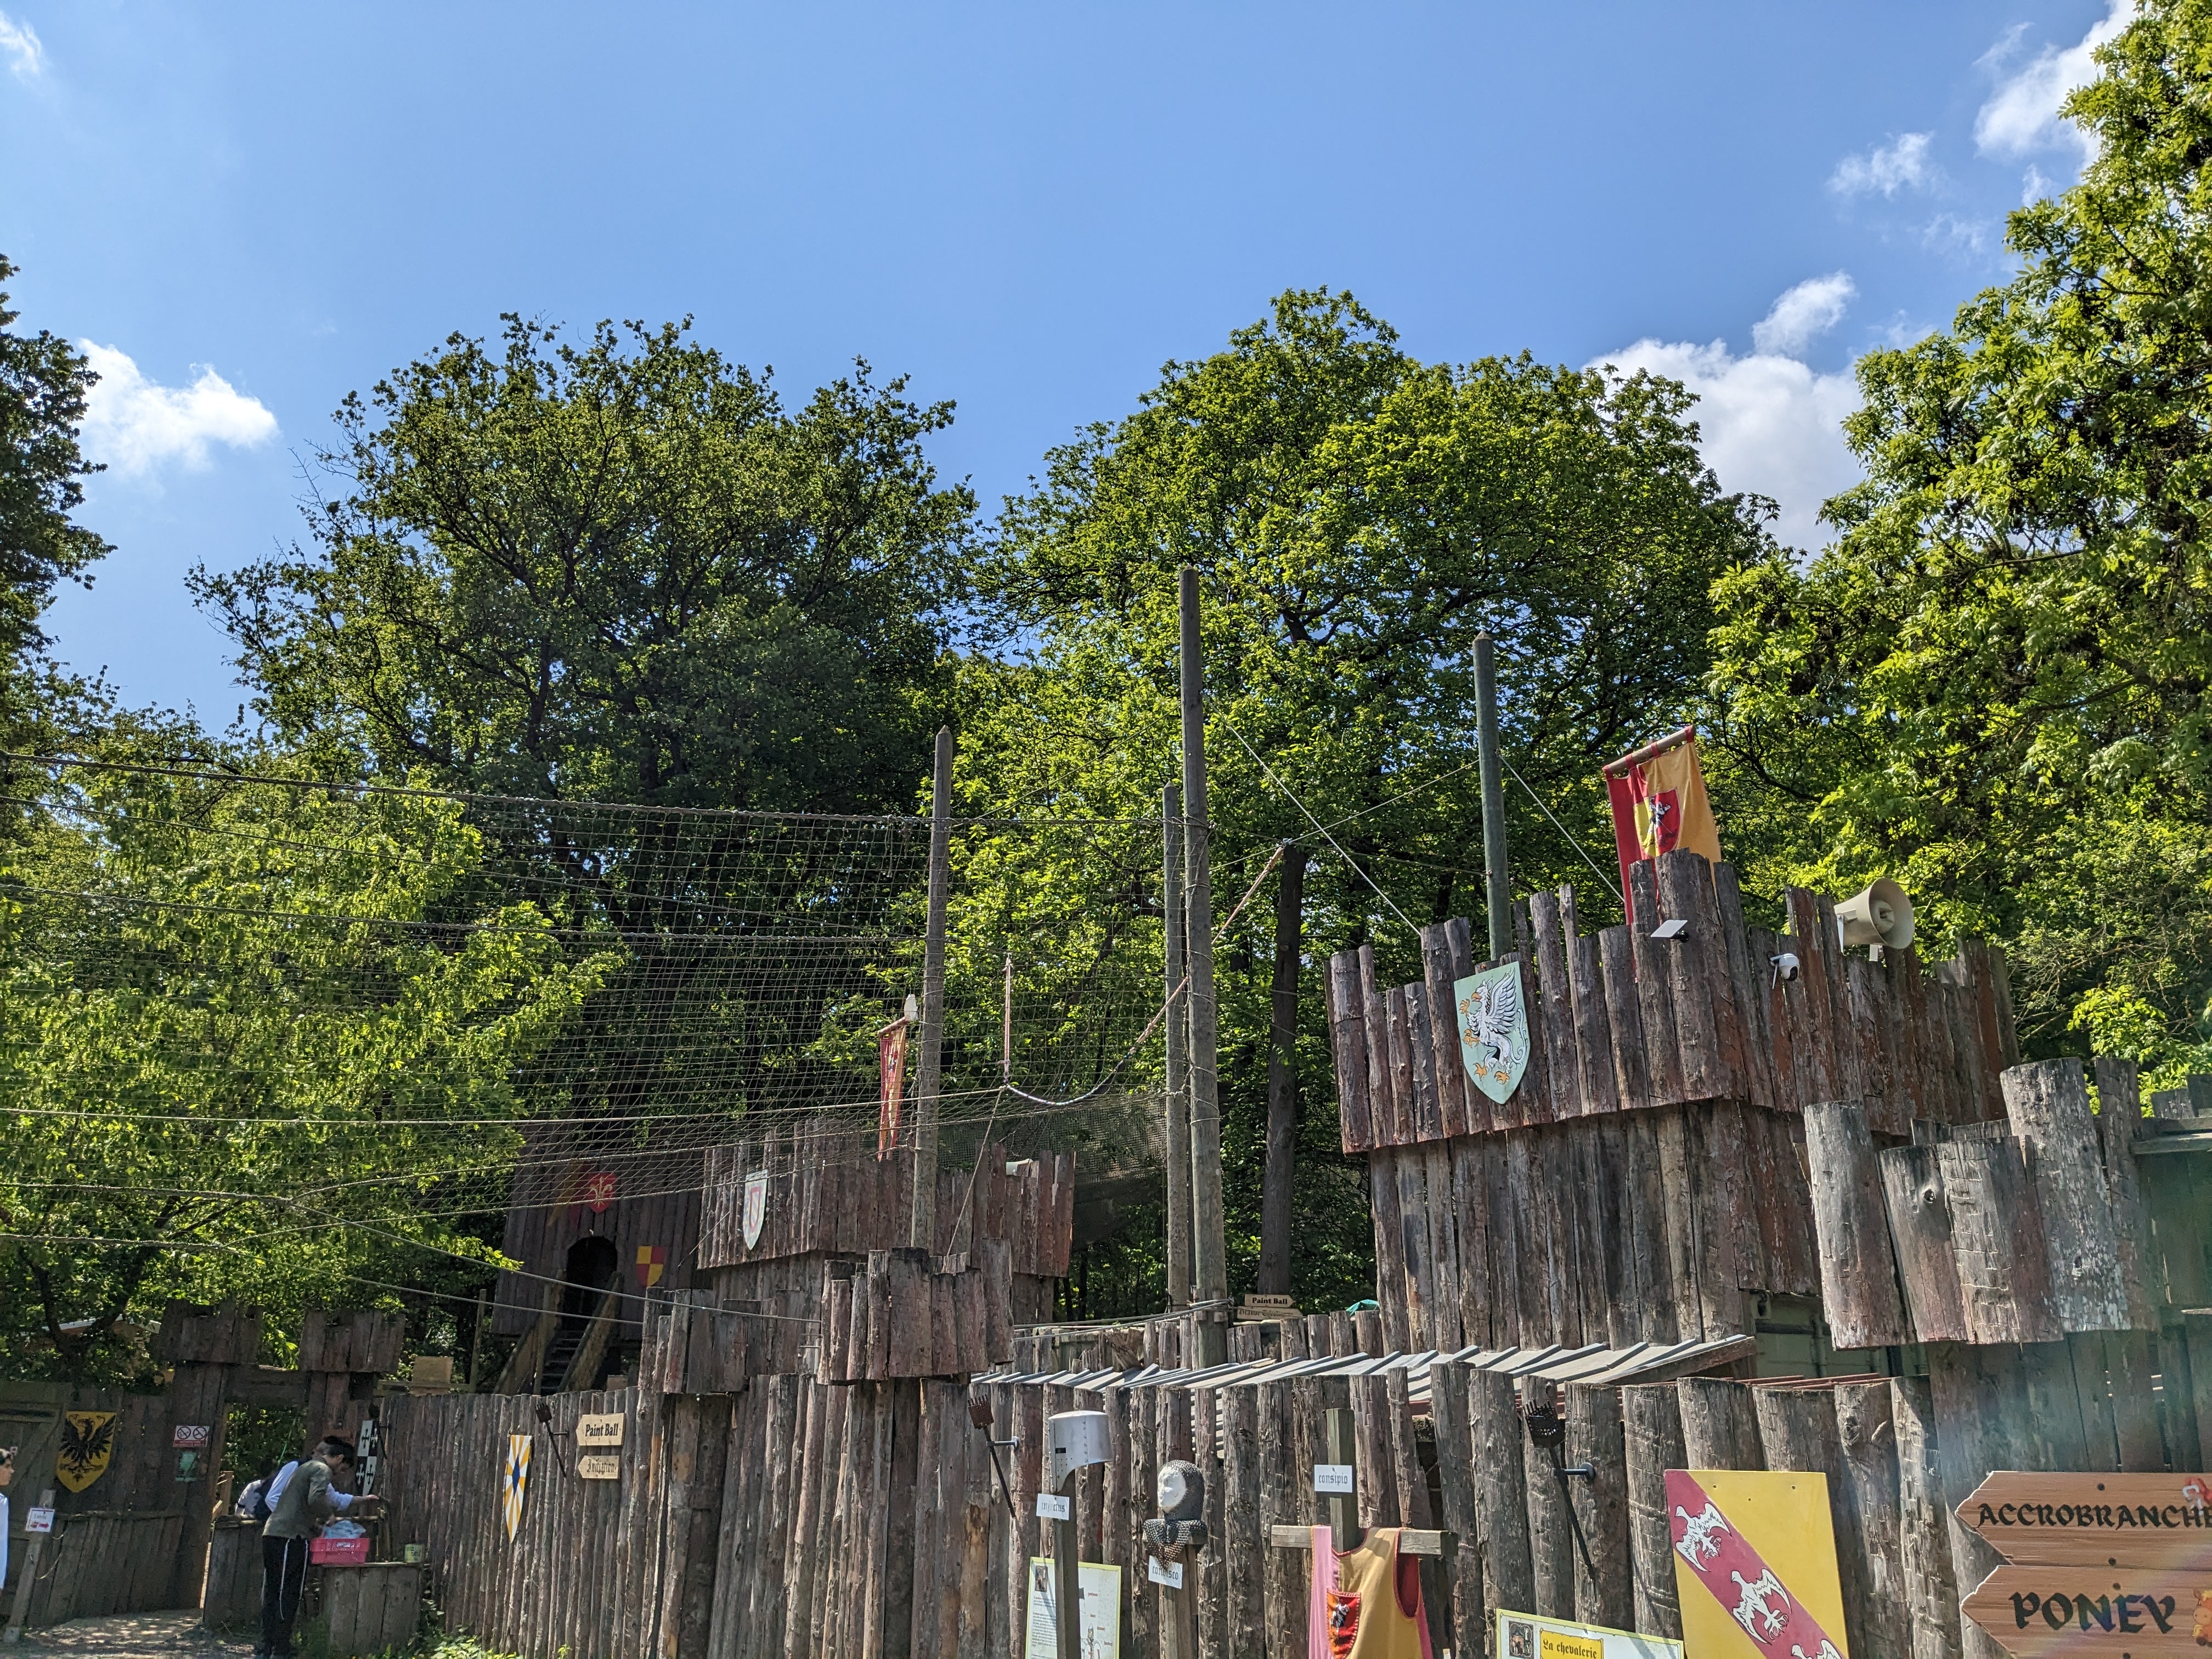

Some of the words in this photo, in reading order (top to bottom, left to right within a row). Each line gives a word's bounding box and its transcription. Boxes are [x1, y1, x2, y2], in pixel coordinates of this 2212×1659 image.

[585, 1424, 604, 1437] Paint
[605, 1423, 619, 1436] Ball
[1318, 1472, 1348, 1486] consipio
[2008, 1592, 2176, 1634] PONEY
[1543, 1638, 1554, 1651] La
[1556, 1641, 1597, 1658] chevalerie
